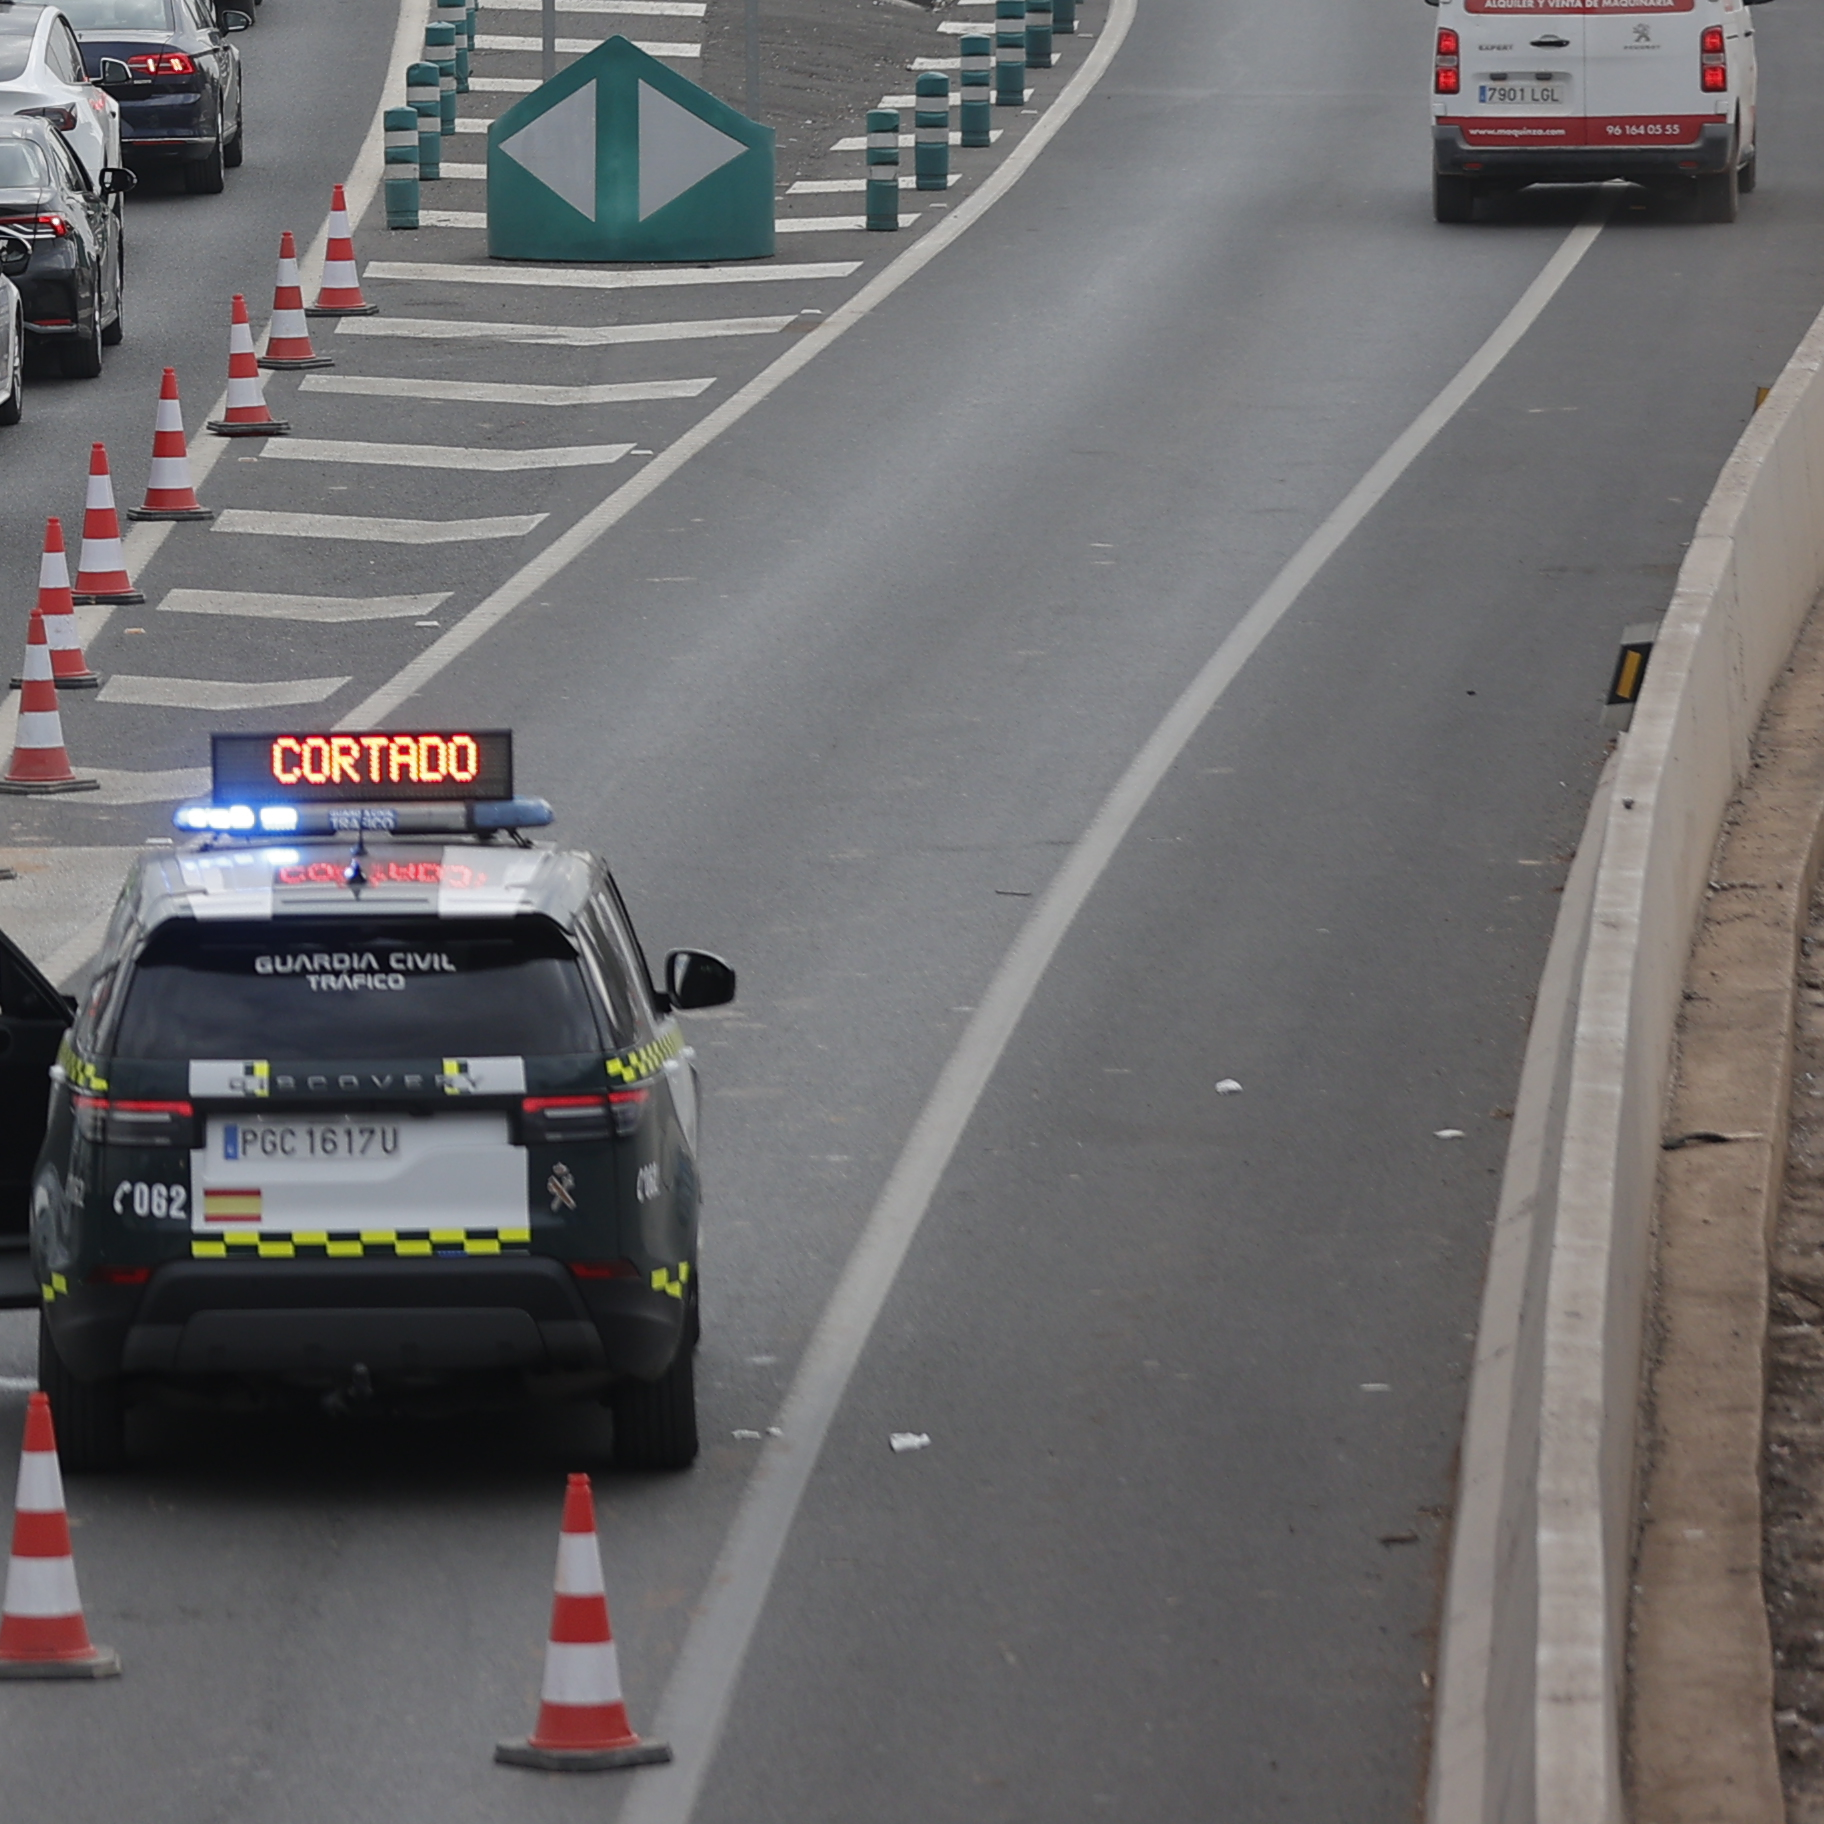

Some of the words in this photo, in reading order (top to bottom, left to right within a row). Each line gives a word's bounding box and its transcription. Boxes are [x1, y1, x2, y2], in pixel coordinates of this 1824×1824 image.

[1487, 87, 1526, 103] 7901
[1531, 87, 1559, 103] LGL
[1468, 126, 1566, 137] www.maquinza.com
[1606, 125, 1622, 136] 96
[1625, 125, 1644, 136] 164
[1646, 125, 1662, 136] 05
[1663, 124, 1680, 135] 55
[270, 734, 480, 785] CORTADO
[254, 954, 379, 974] GUARDIA
[389, 952, 455, 972] CIVIL
[305, 970, 406, 992] TRÁFICO
[228, 1072, 482, 1092] DISCOVERY
[241, 1128, 296, 1157] PGC
[133, 1181, 187, 1220] 062
